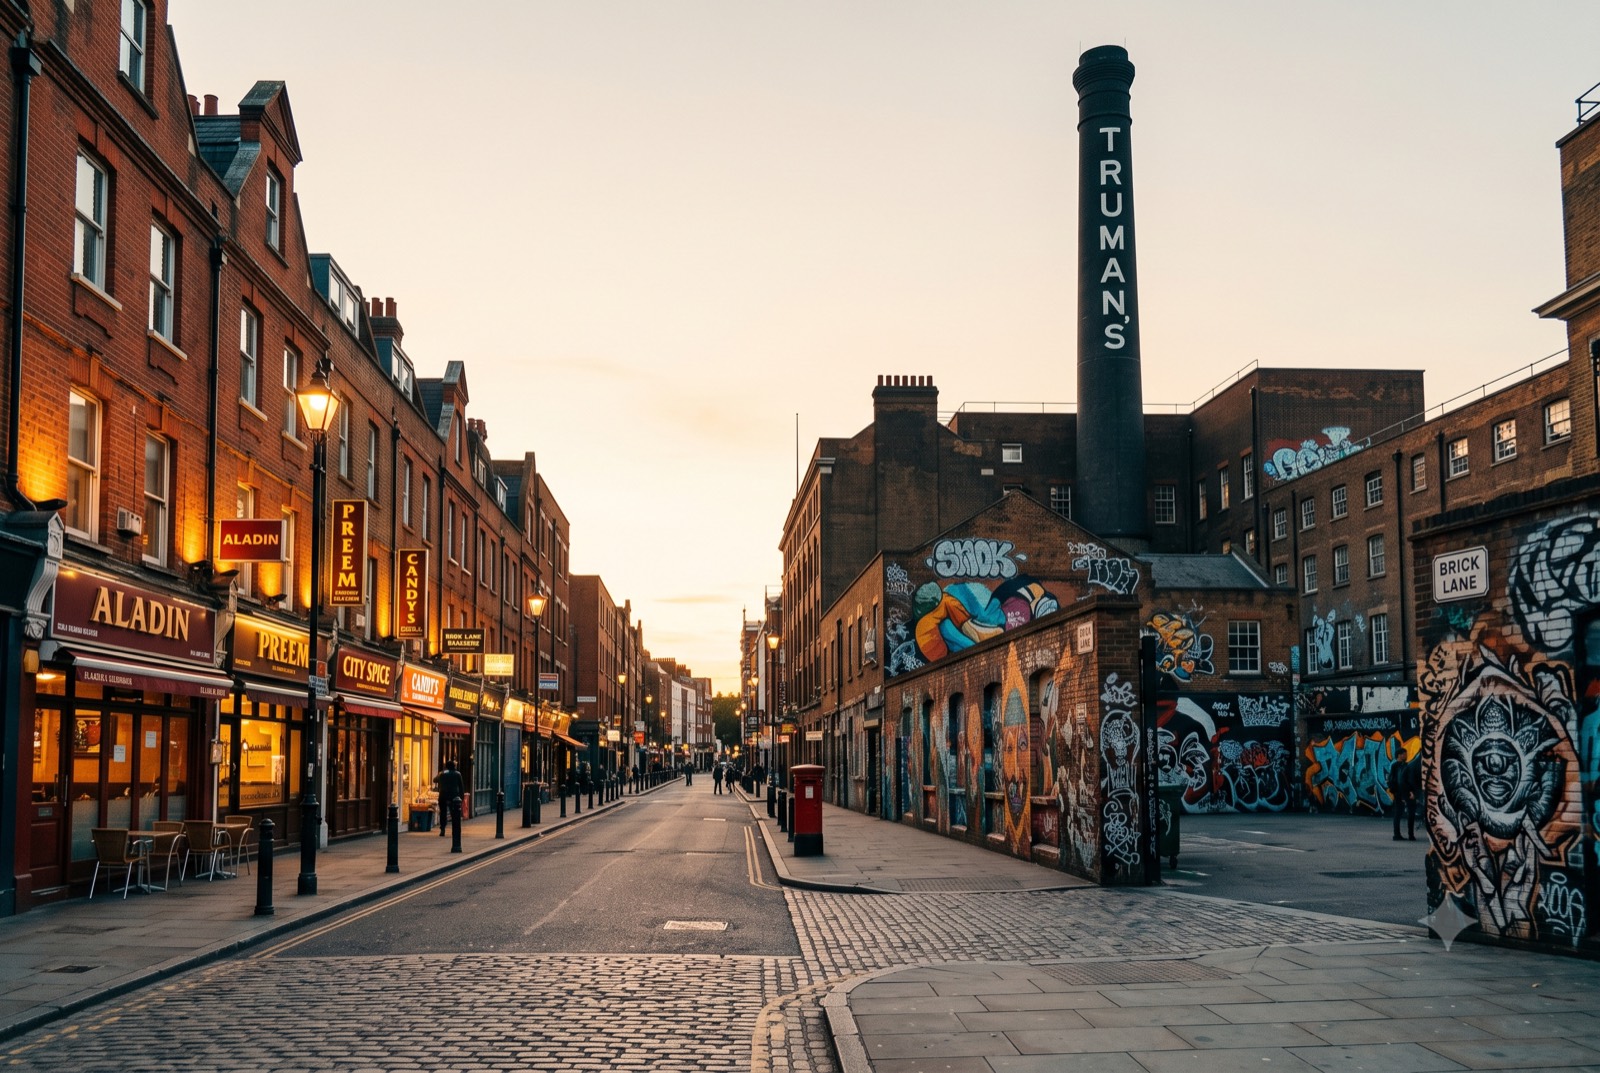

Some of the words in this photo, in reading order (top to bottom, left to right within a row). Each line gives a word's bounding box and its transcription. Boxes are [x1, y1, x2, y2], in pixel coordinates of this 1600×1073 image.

[1099, 126, 1130, 350] TRUMAN'S
[222, 533, 279, 546] ALADIN
[337, 504, 357, 587] PREEM
[1439, 555, 1480, 576] BRICK
[1443, 575, 1477, 594] LANE
[91, 585, 191, 642] ALADIN
[256, 630, 309, 669] PREEM
[343, 655, 367, 680] CITY
[366, 661, 391, 686] SPICE
